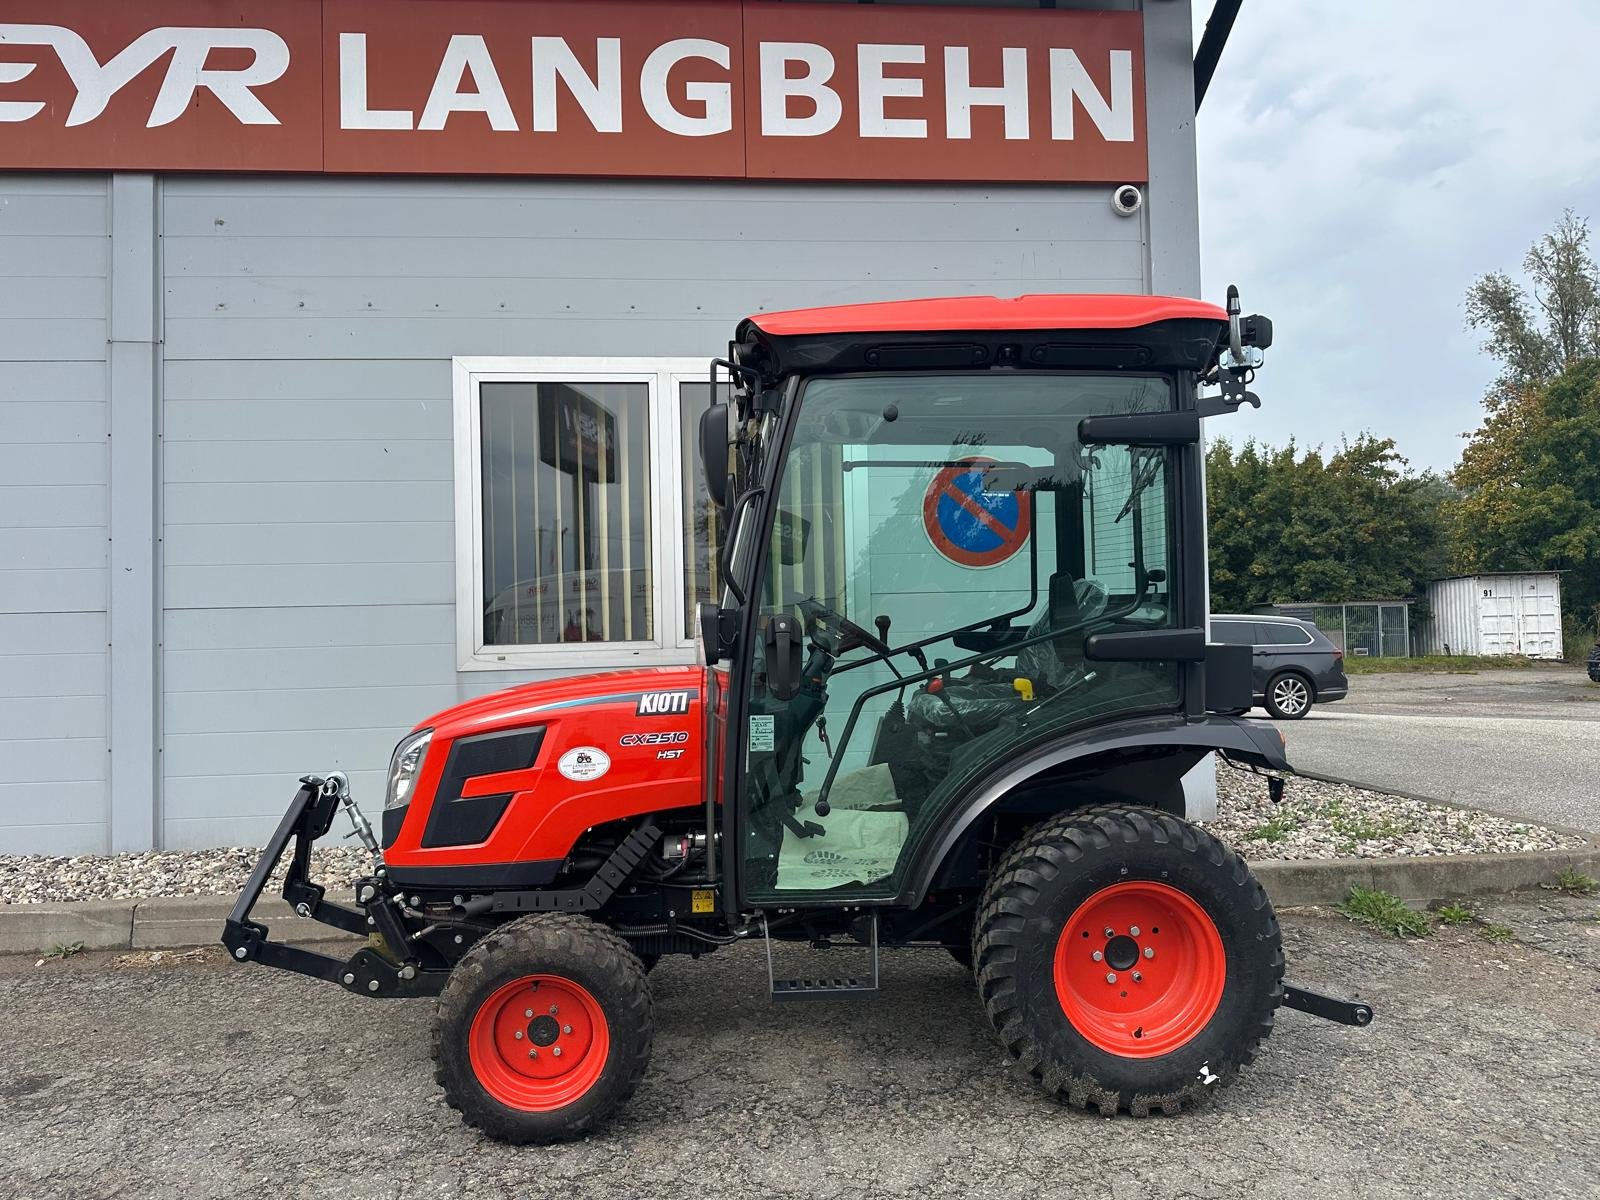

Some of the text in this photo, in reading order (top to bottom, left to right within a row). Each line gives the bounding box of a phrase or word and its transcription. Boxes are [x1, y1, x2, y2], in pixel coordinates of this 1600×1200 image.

[340, 33, 1134, 141] LANGBEHN
[639, 692, 688, 713] KIOTI
[620, 731, 689, 746] CX2510
[657, 749, 685, 759] HST
